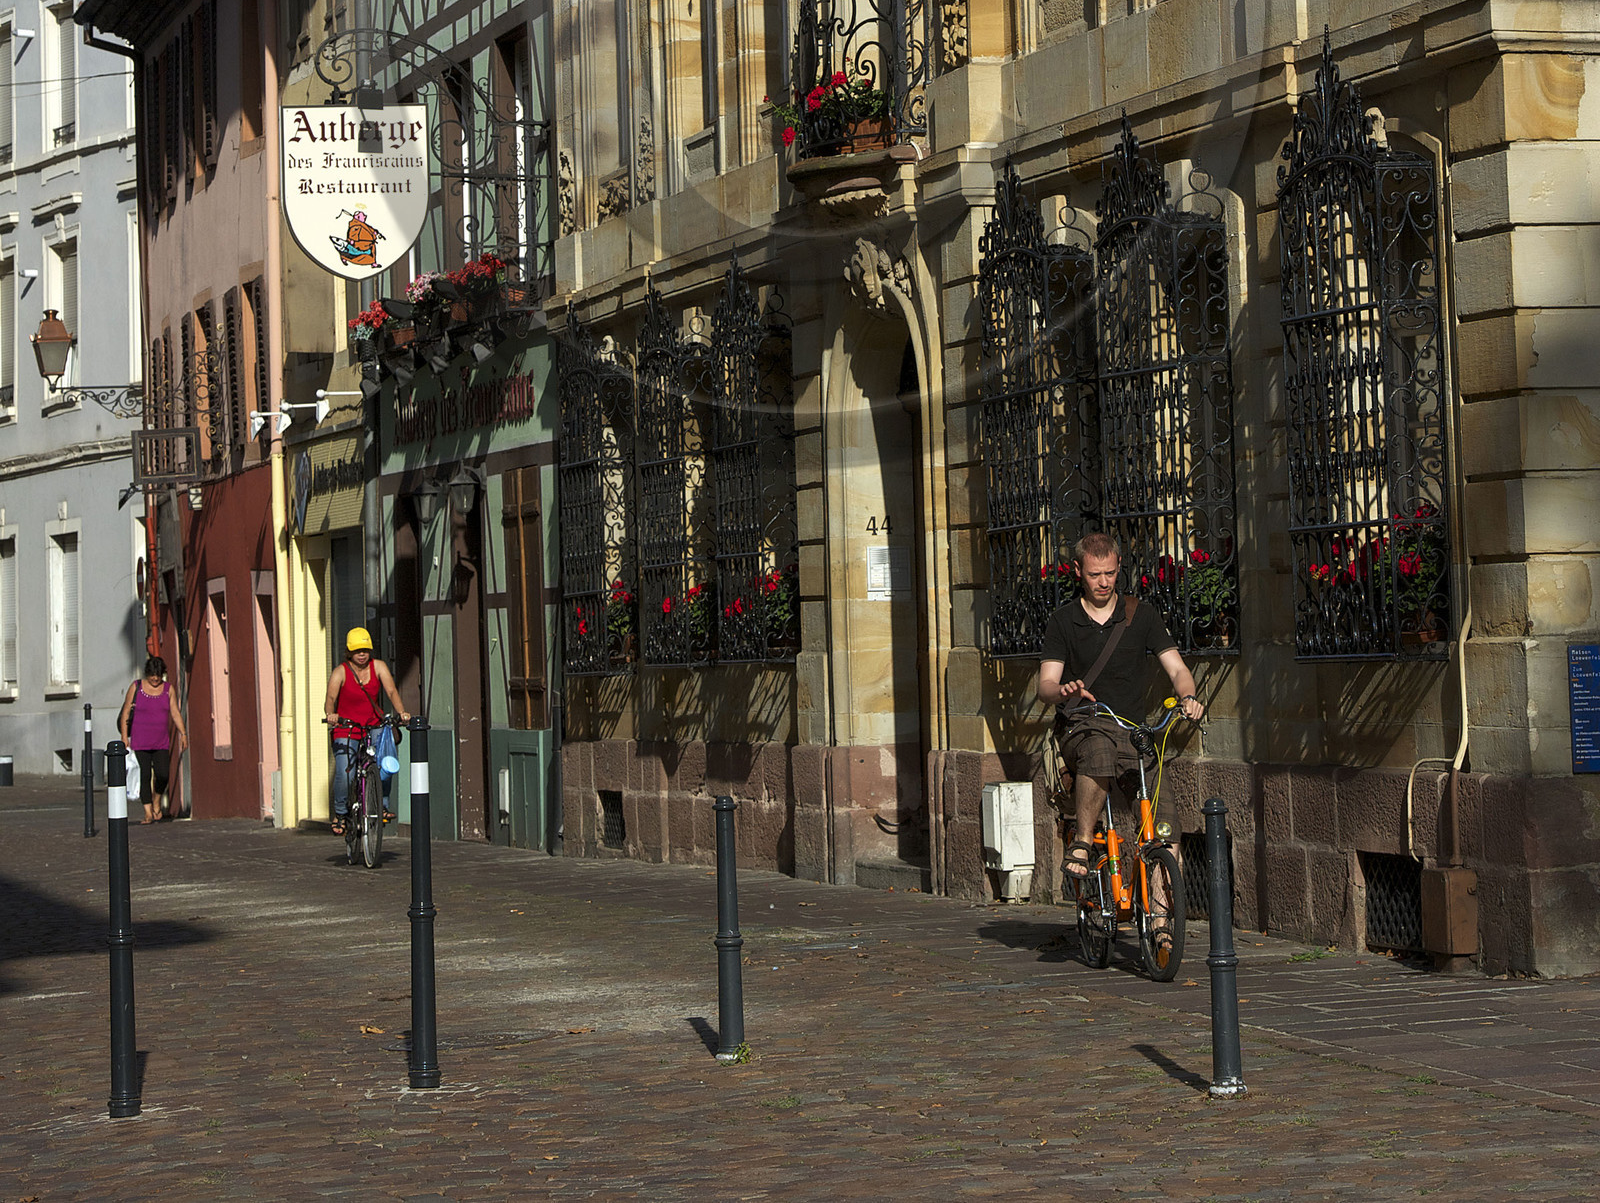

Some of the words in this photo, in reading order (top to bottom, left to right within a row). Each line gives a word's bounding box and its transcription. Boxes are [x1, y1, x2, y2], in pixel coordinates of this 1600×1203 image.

[288, 110, 423, 149] Auberge
[288, 153, 313, 169] des
[322, 152, 423, 169] Franciscains
[298, 178, 412, 194] Restaurant
[866, 515, 893, 536] 44
